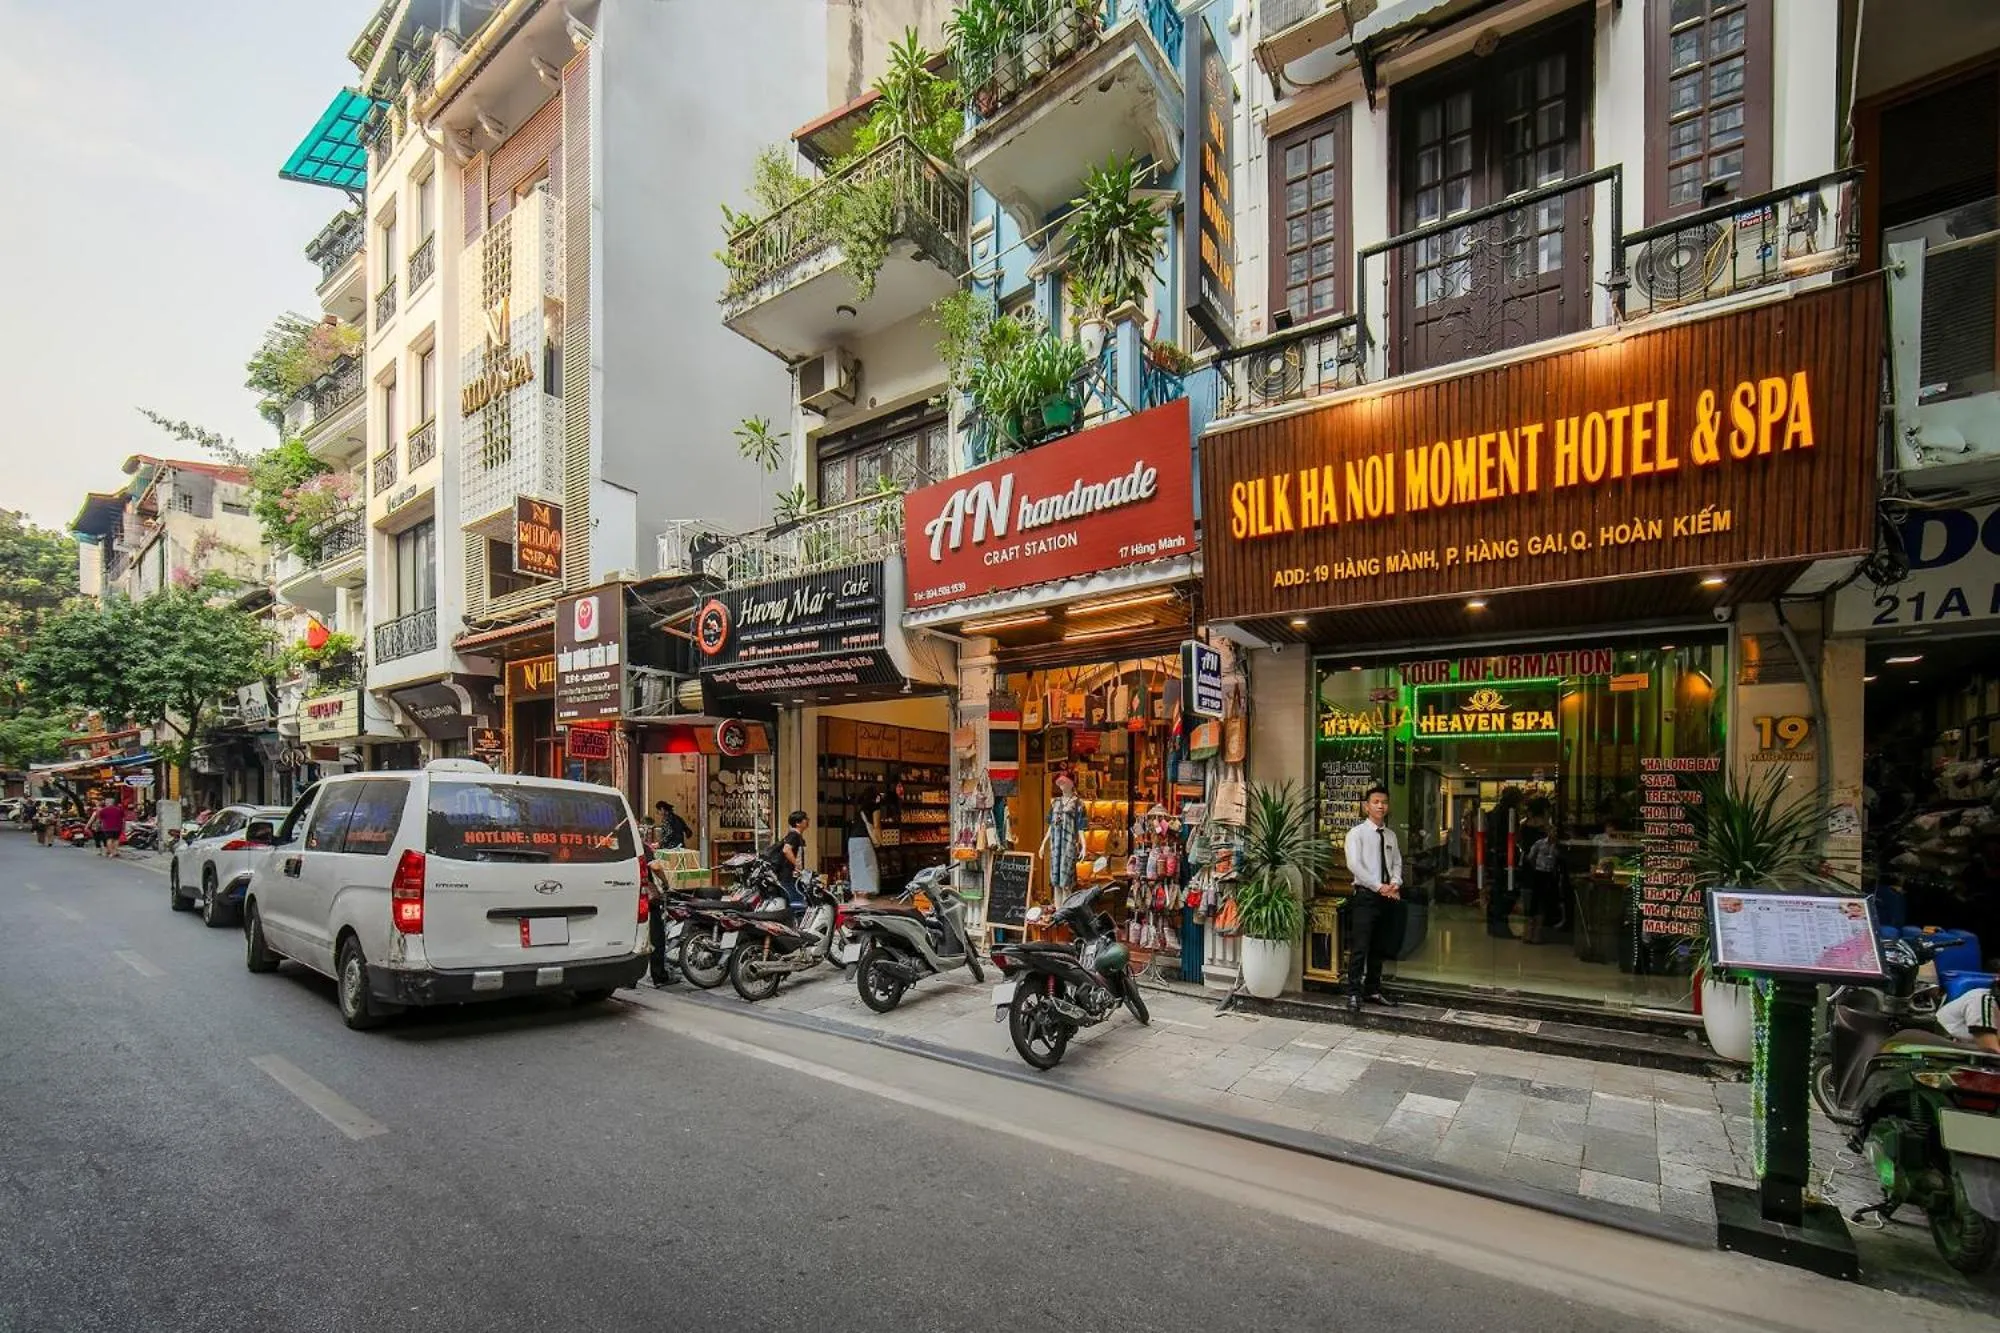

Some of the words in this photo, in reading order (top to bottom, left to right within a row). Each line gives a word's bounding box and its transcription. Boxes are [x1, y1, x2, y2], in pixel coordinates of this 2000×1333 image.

[1232, 472, 1294, 540] SILK
[1300, 465, 1339, 529] HA
[1345, 453, 1395, 522] NOI
[1405, 423, 1544, 513] MOMENT
[1554, 398, 1680, 489] HOTEL
[1690, 388, 1721, 467] &
[1729, 370, 1815, 460] SPA
[924, 472, 1014, 562] AN
[1016, 460, 1158, 532] handmade
[984, 545, 1021, 566] CRAFT
[1024, 531, 1078, 557] STATION
[1118, 546, 1129, 559] 17
[1273, 569, 1311, 588] ADD:
[1313, 563, 1330, 583] 19
[1334, 556, 1380, 581] HÀNG
[1385, 549, 1439, 574] MÀNH,
[1446, 547, 1460, 567] P.
[1465, 538, 1519, 564] HÀNG
[1600, 517, 1663, 547] HOÀN
[1672, 504, 1732, 538] KIẾM
[786, 586, 826, 624] Mai
[1871, 585, 1972, 626] 21A
[1400, 660, 1450, 686] TOUR
[1459, 647, 1614, 681] INFORMATION
[1421, 711, 1506, 734] HEAVEN
[1511, 710, 1556, 731] SPA
[1752, 714, 1810, 751] 19
[1663, 758, 1696, 772] LONG
[1696, 758, 1721, 772] BAY
[464, 831, 530, 845] HOTLINE:
[533, 832, 557, 845] 093
[560, 833, 583, 845] 675
